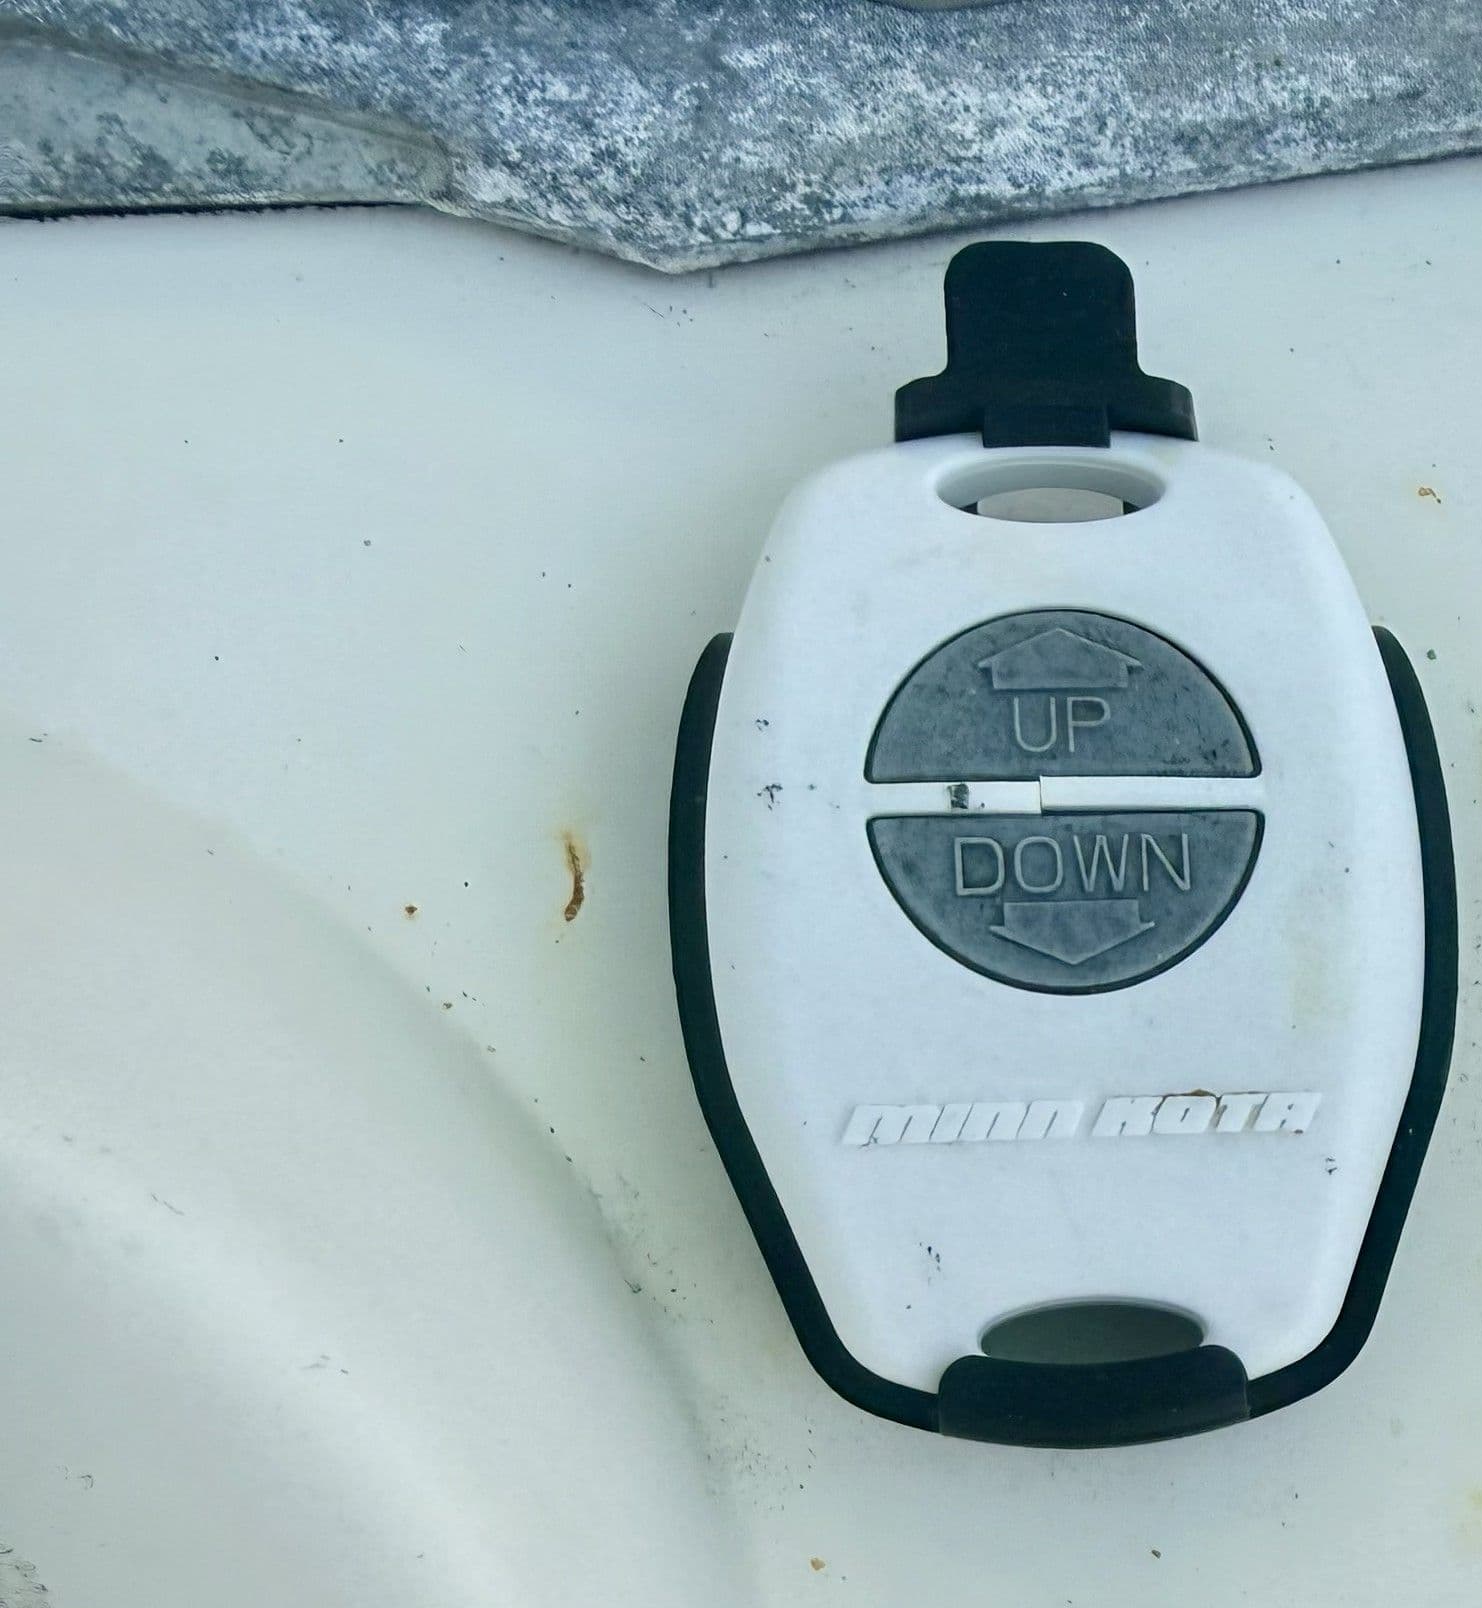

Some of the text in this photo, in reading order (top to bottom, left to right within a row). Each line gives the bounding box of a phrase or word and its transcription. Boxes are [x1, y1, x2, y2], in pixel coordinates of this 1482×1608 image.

[1013, 696, 1112, 753] UP
[954, 833, 1191, 896] DOWN
[1092, 1092, 1321, 1137] KOTA
